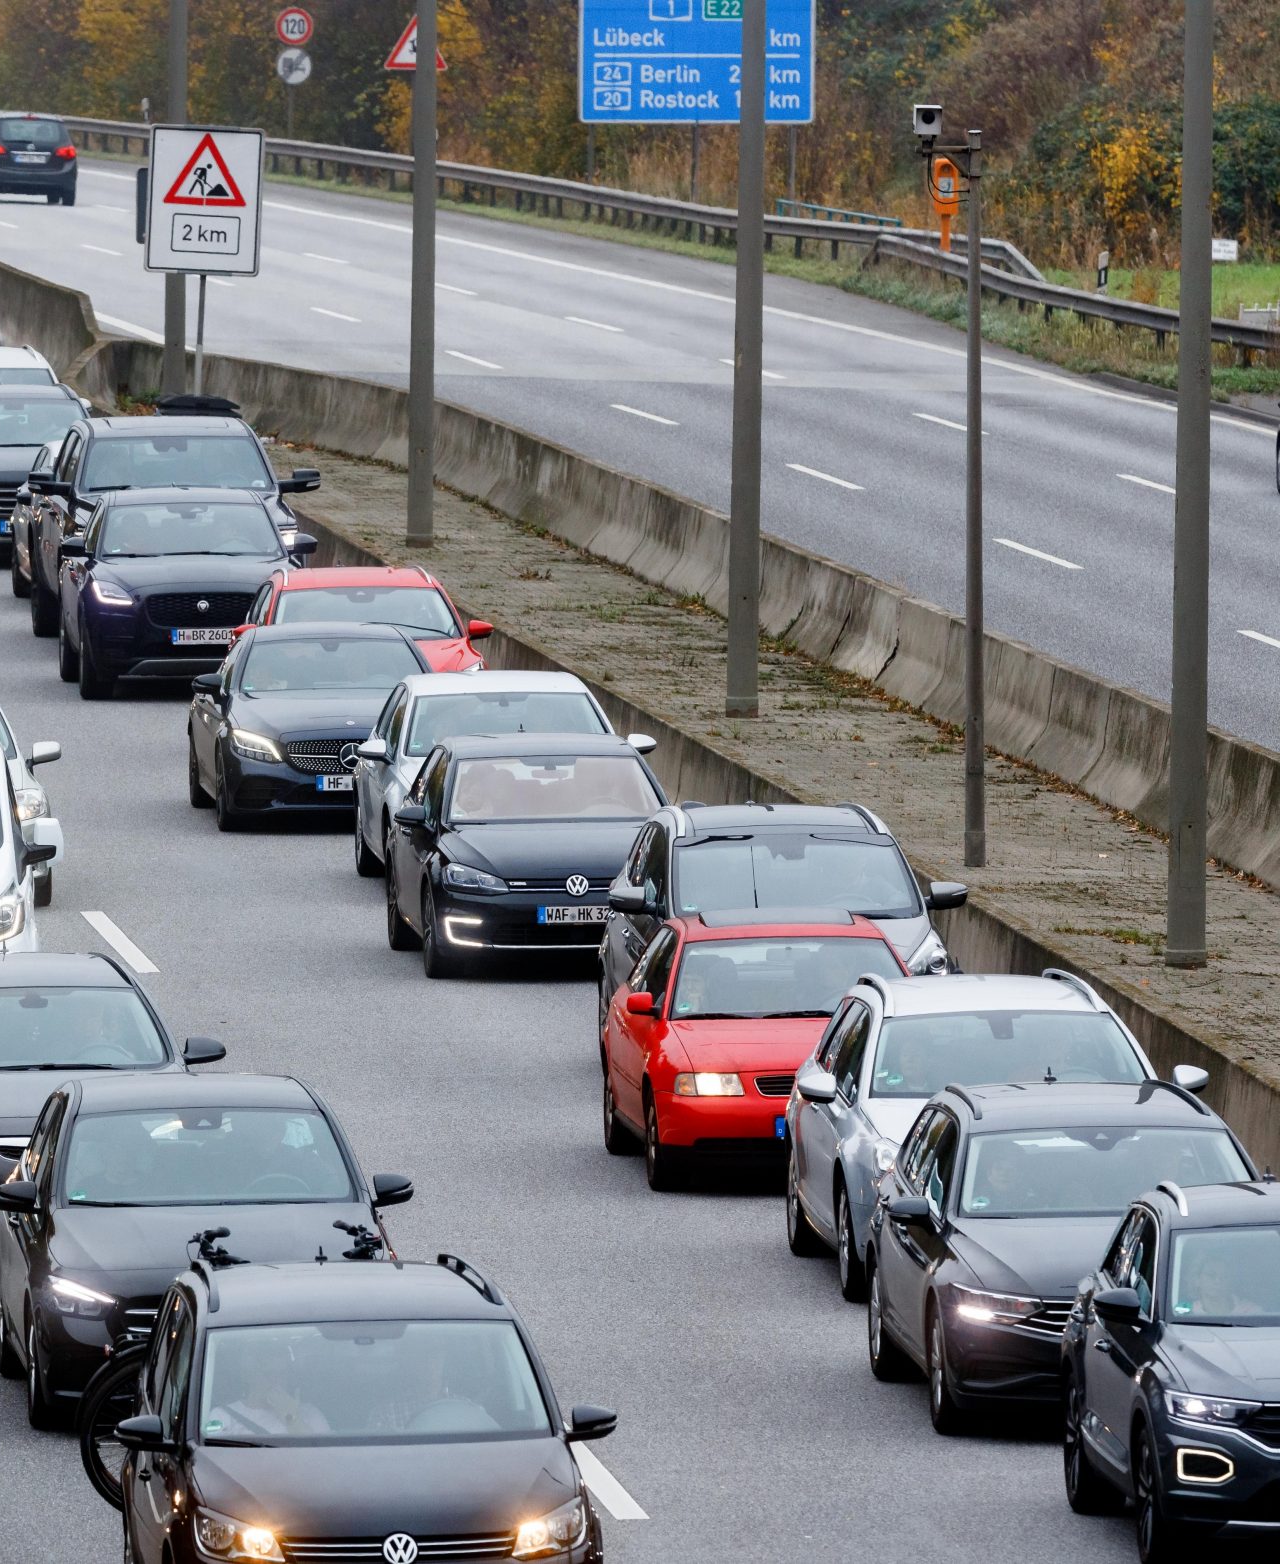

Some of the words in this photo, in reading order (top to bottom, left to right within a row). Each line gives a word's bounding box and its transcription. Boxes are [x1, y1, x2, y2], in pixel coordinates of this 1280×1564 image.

[668, 0, 674, 16] 1
[284, 18, 305, 35] 120
[593, 28, 665, 47] Lübeck
[770, 28, 801, 47] km
[603, 67, 622, 81] 24
[640, 64, 700, 83] Berlin
[770, 65, 801, 83] km
[603, 92, 622, 106] 20
[640, 90, 719, 109] Rostock
[770, 90, 801, 108] km
[182, 224, 192, 241] 2
[198, 224, 227, 243] km
[178, 630, 185, 641] H
[192, 630, 206, 641] BR
[208, 629, 233, 641] 2601
[328, 776, 343, 789] HF
[546, 907, 569, 921] WAF
[577, 907, 594, 921] HK
